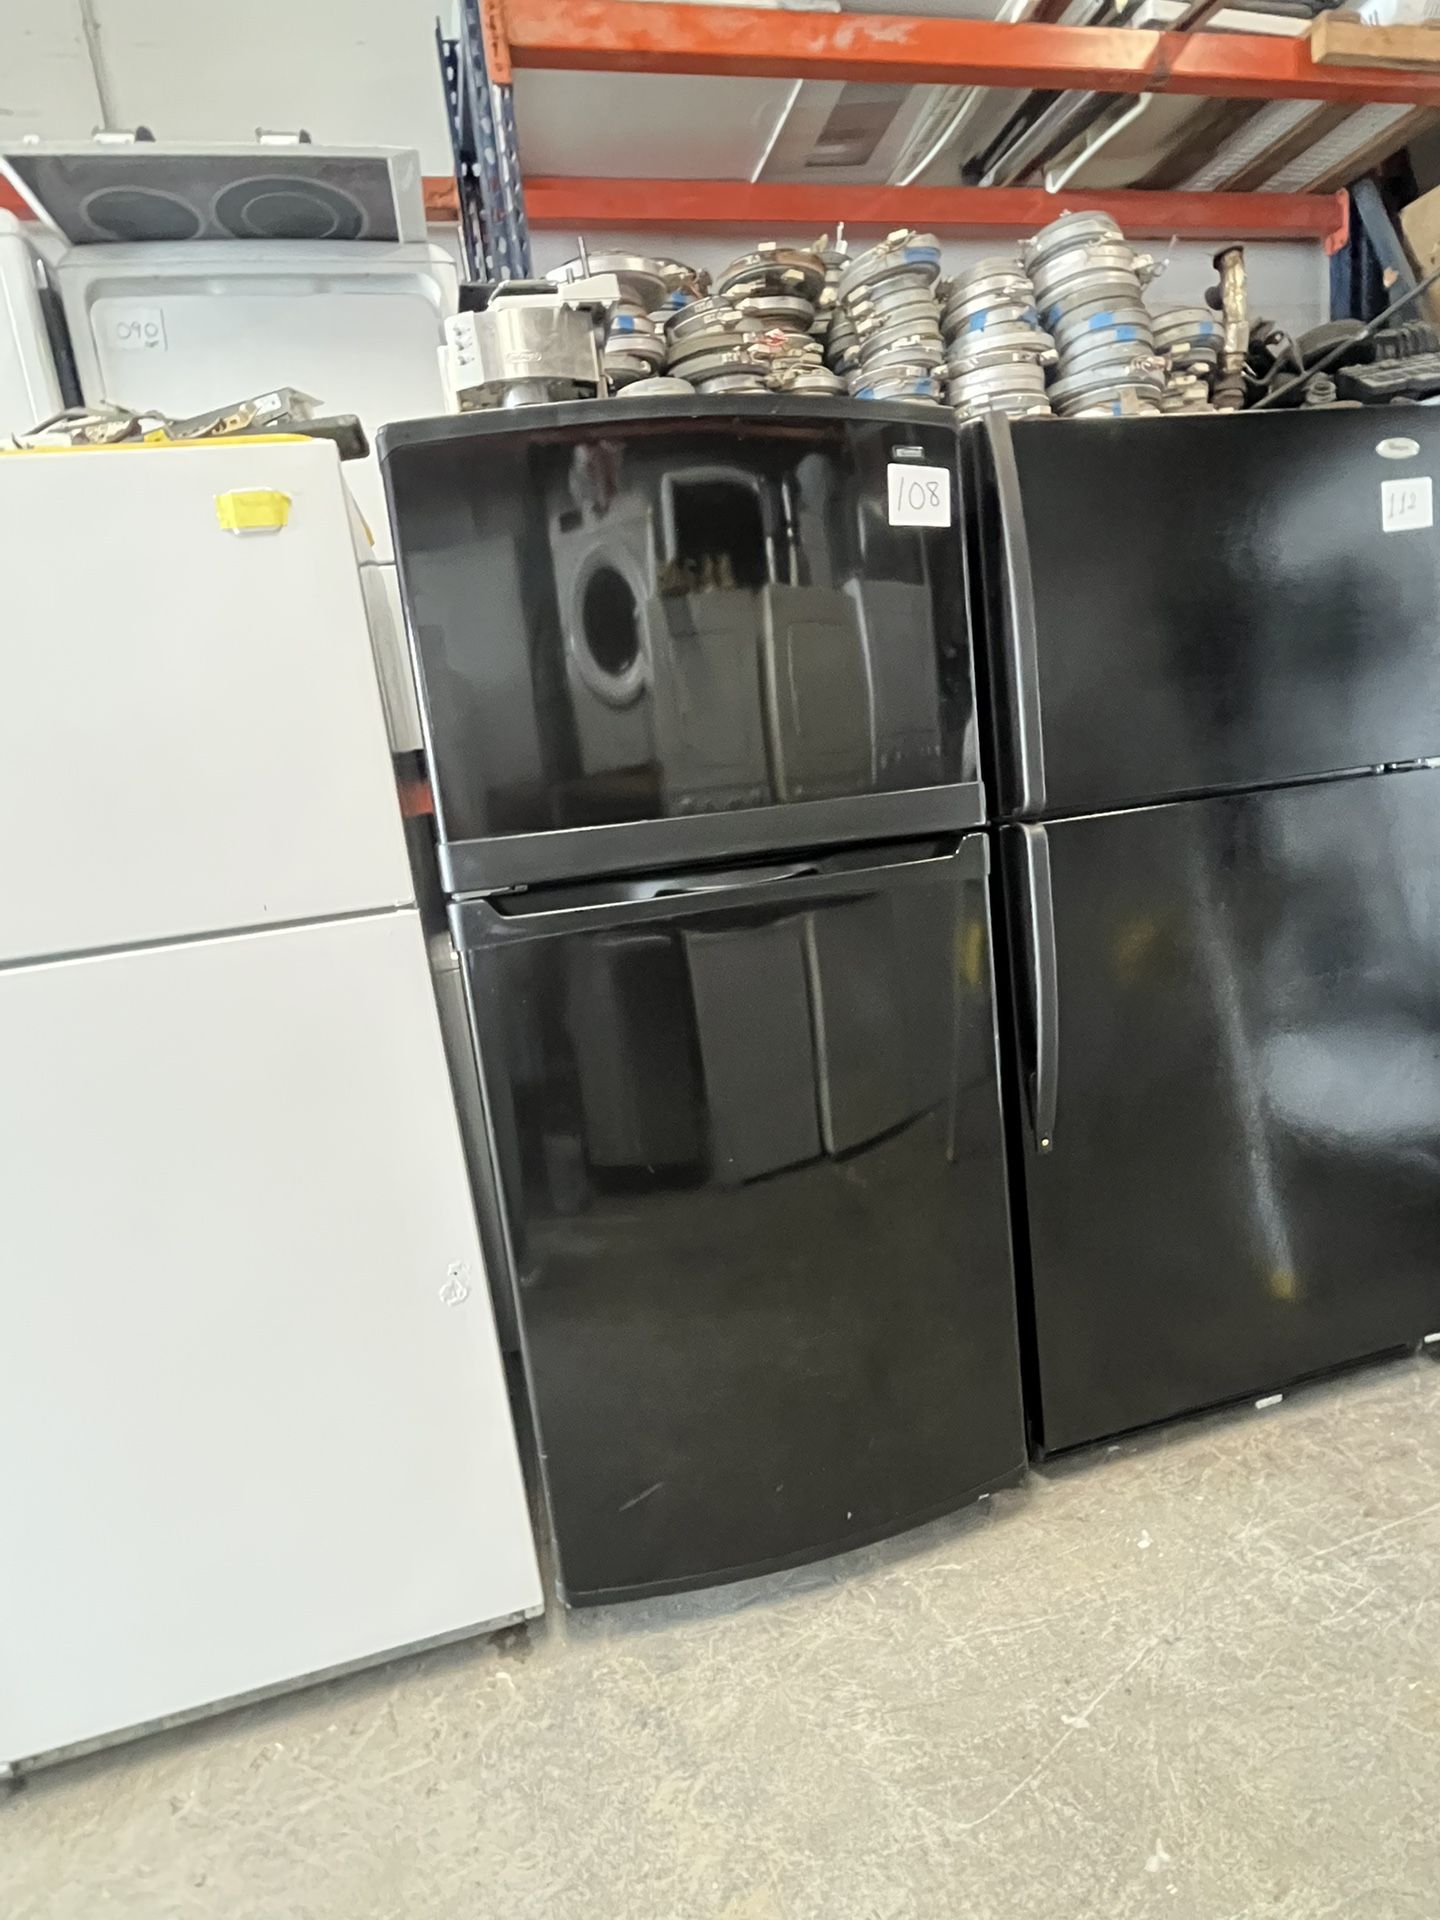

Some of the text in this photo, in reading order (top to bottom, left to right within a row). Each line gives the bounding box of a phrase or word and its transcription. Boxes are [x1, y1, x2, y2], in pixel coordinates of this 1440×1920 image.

[116, 321, 159, 340] 090
[897, 476, 941, 512] 108
[1388, 491, 1417, 519] 112
